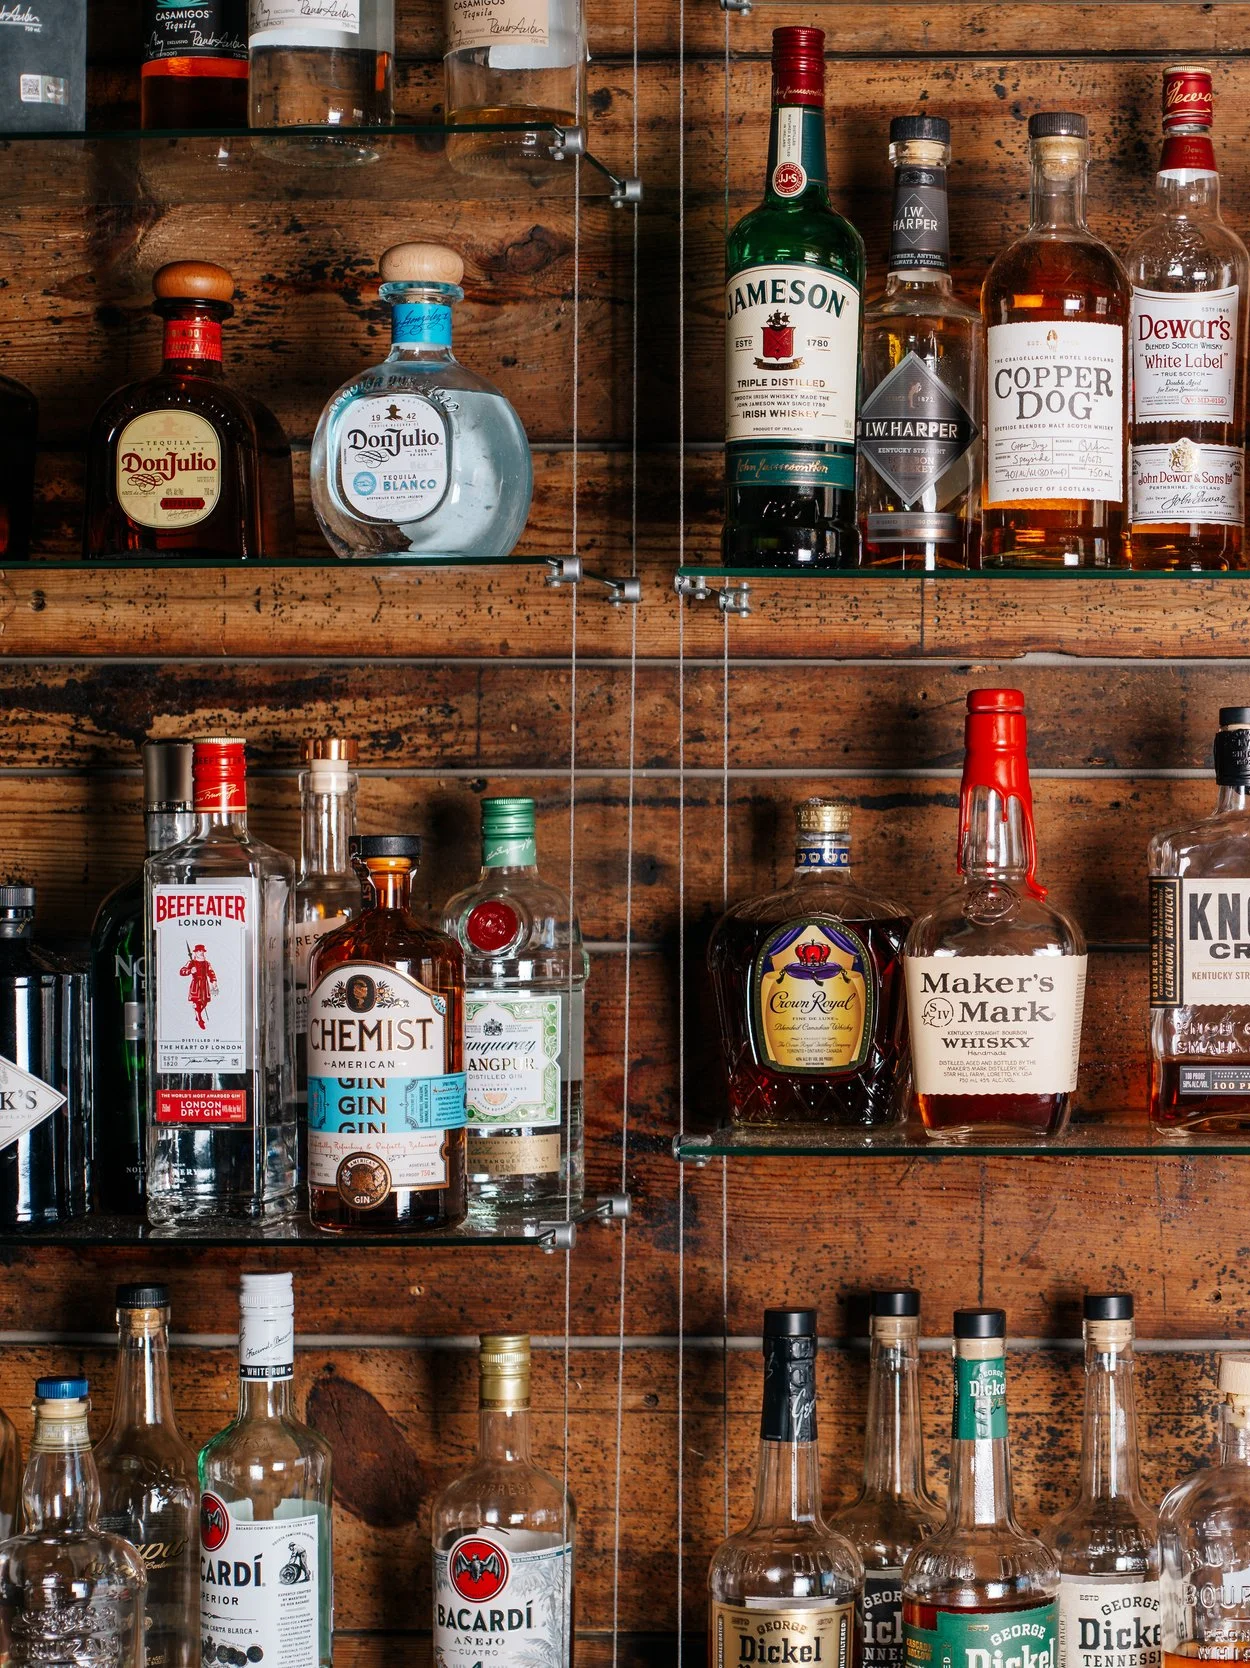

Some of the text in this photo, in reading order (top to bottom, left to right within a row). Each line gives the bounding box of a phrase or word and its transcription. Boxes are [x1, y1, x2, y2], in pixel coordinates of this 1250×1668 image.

[155, 10, 210, 21] CASAMIGOS
[463, 10, 493, 20] Tequila
[165, 21, 196, 30] Tequila
[904, 206, 924, 218] I.W.
[892, 218, 938, 232] HARPER
[727, 279, 846, 320] JAMESON
[1138, 314, 1231, 341] Dewar's
[806, 339, 829, 348] 1780
[737, 378, 826, 389] TRIPLE DISTILLED
[994, 365, 1114, 399] COPPER
[1016, 389, 1093, 420] DOG
[406, 412, 417, 420] 42
[742, 409, 820, 419] IRISH WHISKEY
[865, 421, 958, 439] I.W. HARPER
[383, 479, 437, 492] BLANCO
[155, 894, 247, 923] BEEFEATER
[178, 919, 223, 927] LONDON
[1191, 971, 1234, 981] KENTUCKY
[920, 972, 1055, 994] Maker's
[769, 990, 856, 1014] Crown Royal
[957, 1001, 1054, 1024] Mark
[310, 1017, 434, 1052] CHEMIST
[940, 1037, 1035, 1049] WHISKY
[330, 1059, 396, 1069] AMERICAN
[468, 1056, 538, 1072] ANGPUR
[180, 1100, 221, 1109] LONDON
[337, 1095, 388, 1116] GIN
[180, 1109, 222, 1117] DRY GIN
[349, 1158, 377, 1168] AMERICAN
[353, 1195, 371, 1204] GIN
[246, 1366, 286, 1376] WHITE RUM
[200, 1552, 264, 1588] CARDÍ
[200, 1592, 239, 1606] PERIOR
[862, 1589, 903, 1608] GEOR
[1100, 1596, 1161, 1616] GEORGE
[437, 1600, 534, 1633] BACARDÍ
[210, 1625, 253, 1635] CARTA BLANCA
[756, 1620, 809, 1636] GEORGE
[454, 1635, 505, 1646] AÑEJO
[989, 1623, 1046, 1647] GEORGE
[458, 1648, 499, 1656] CUATRO
[738, 1634, 822, 1665] Dickel
